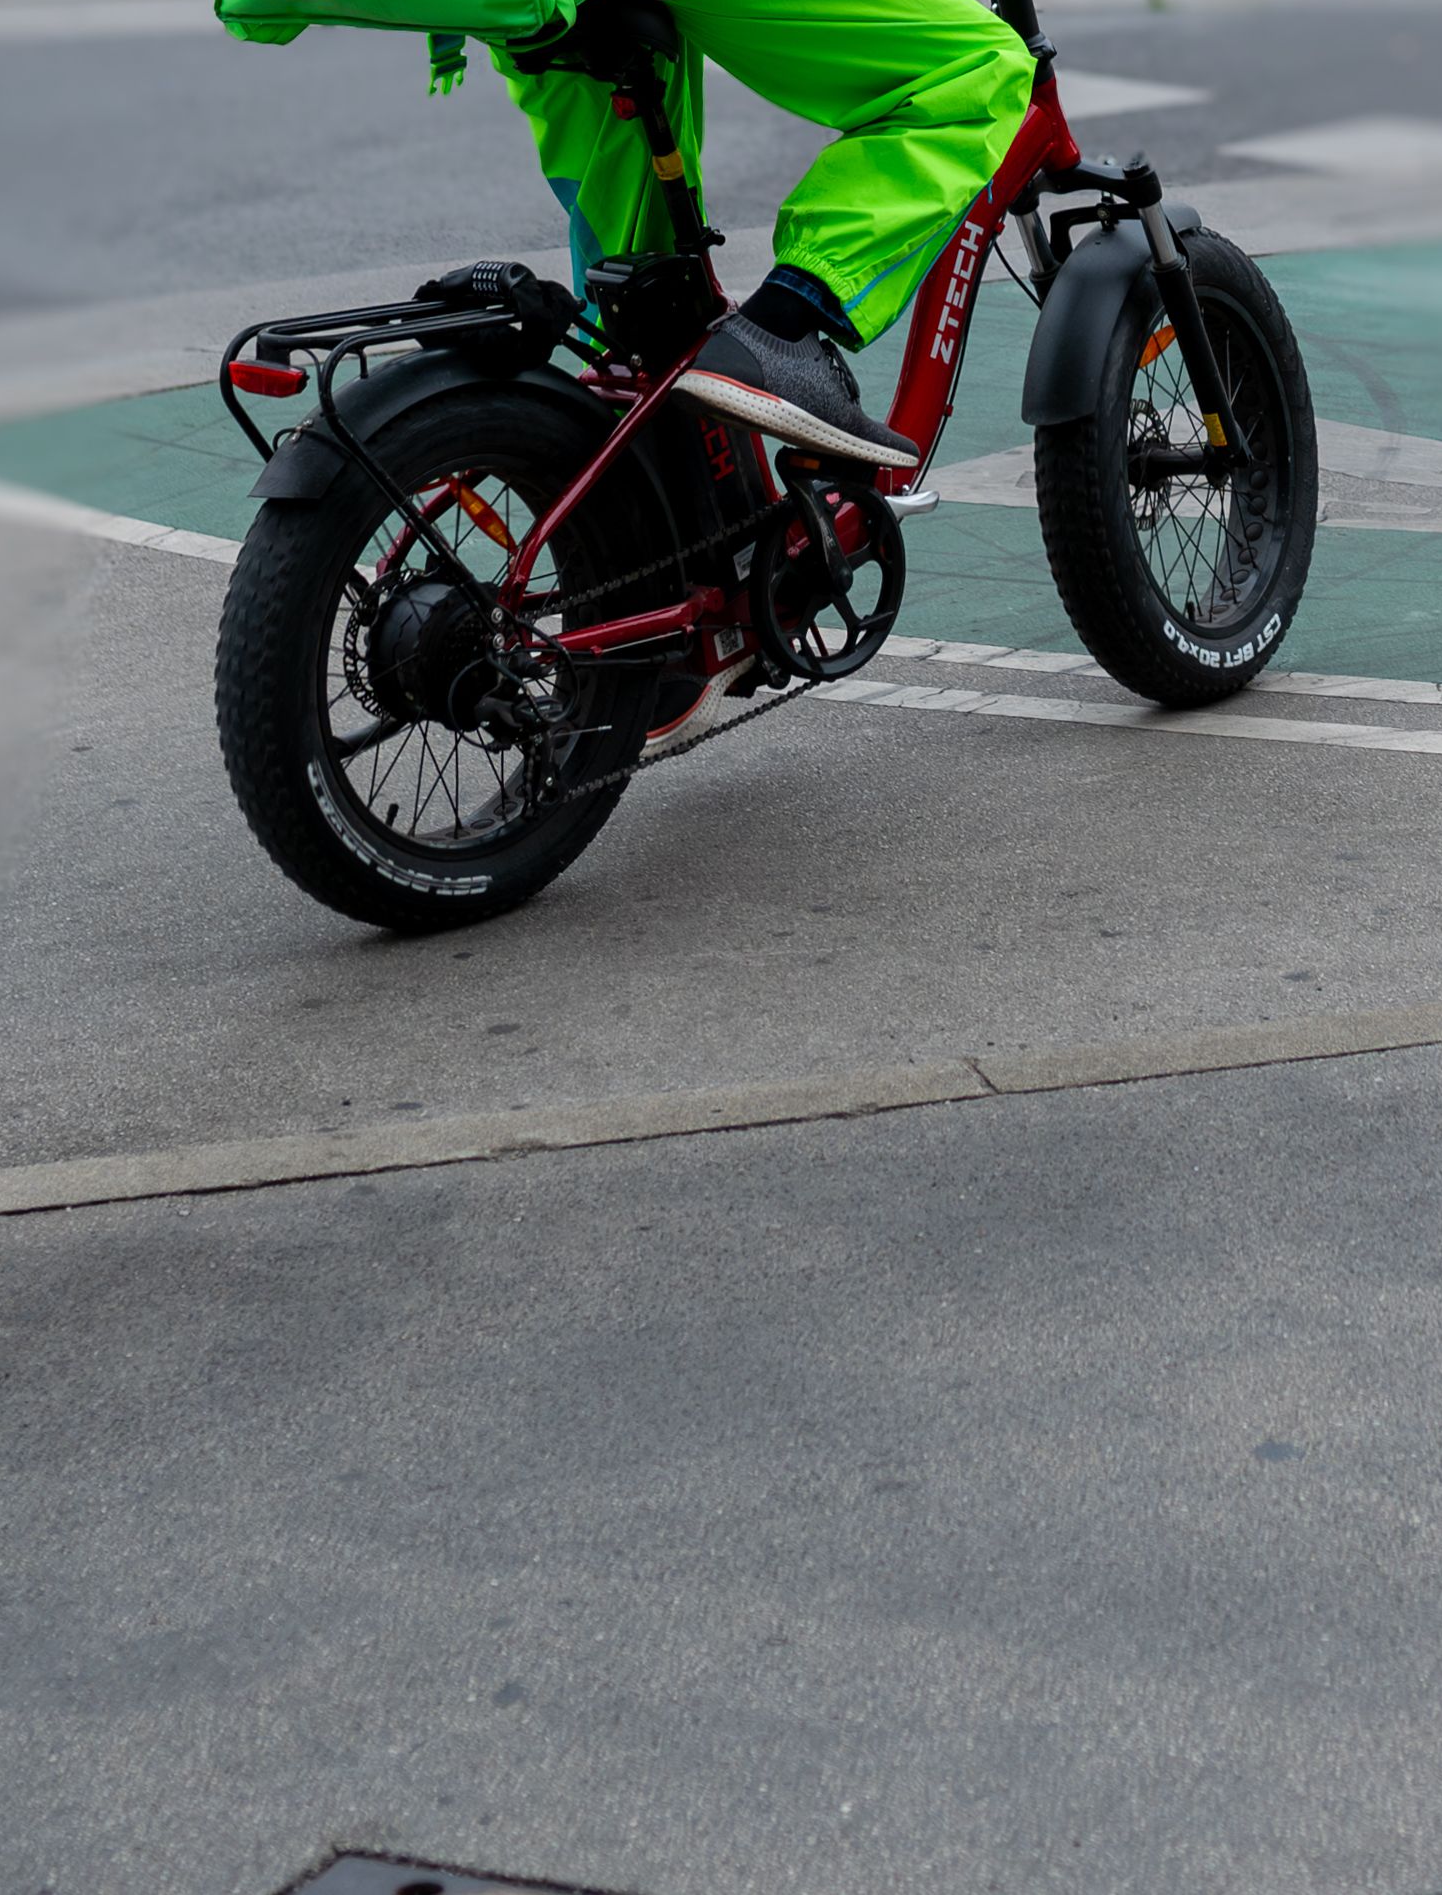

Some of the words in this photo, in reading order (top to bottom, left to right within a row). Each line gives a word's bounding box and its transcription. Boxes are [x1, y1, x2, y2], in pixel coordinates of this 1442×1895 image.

[930, 220, 984, 365] ZTECH
[1256, 612, 1282, 653] CST
[1223, 641, 1256, 669] BFT
